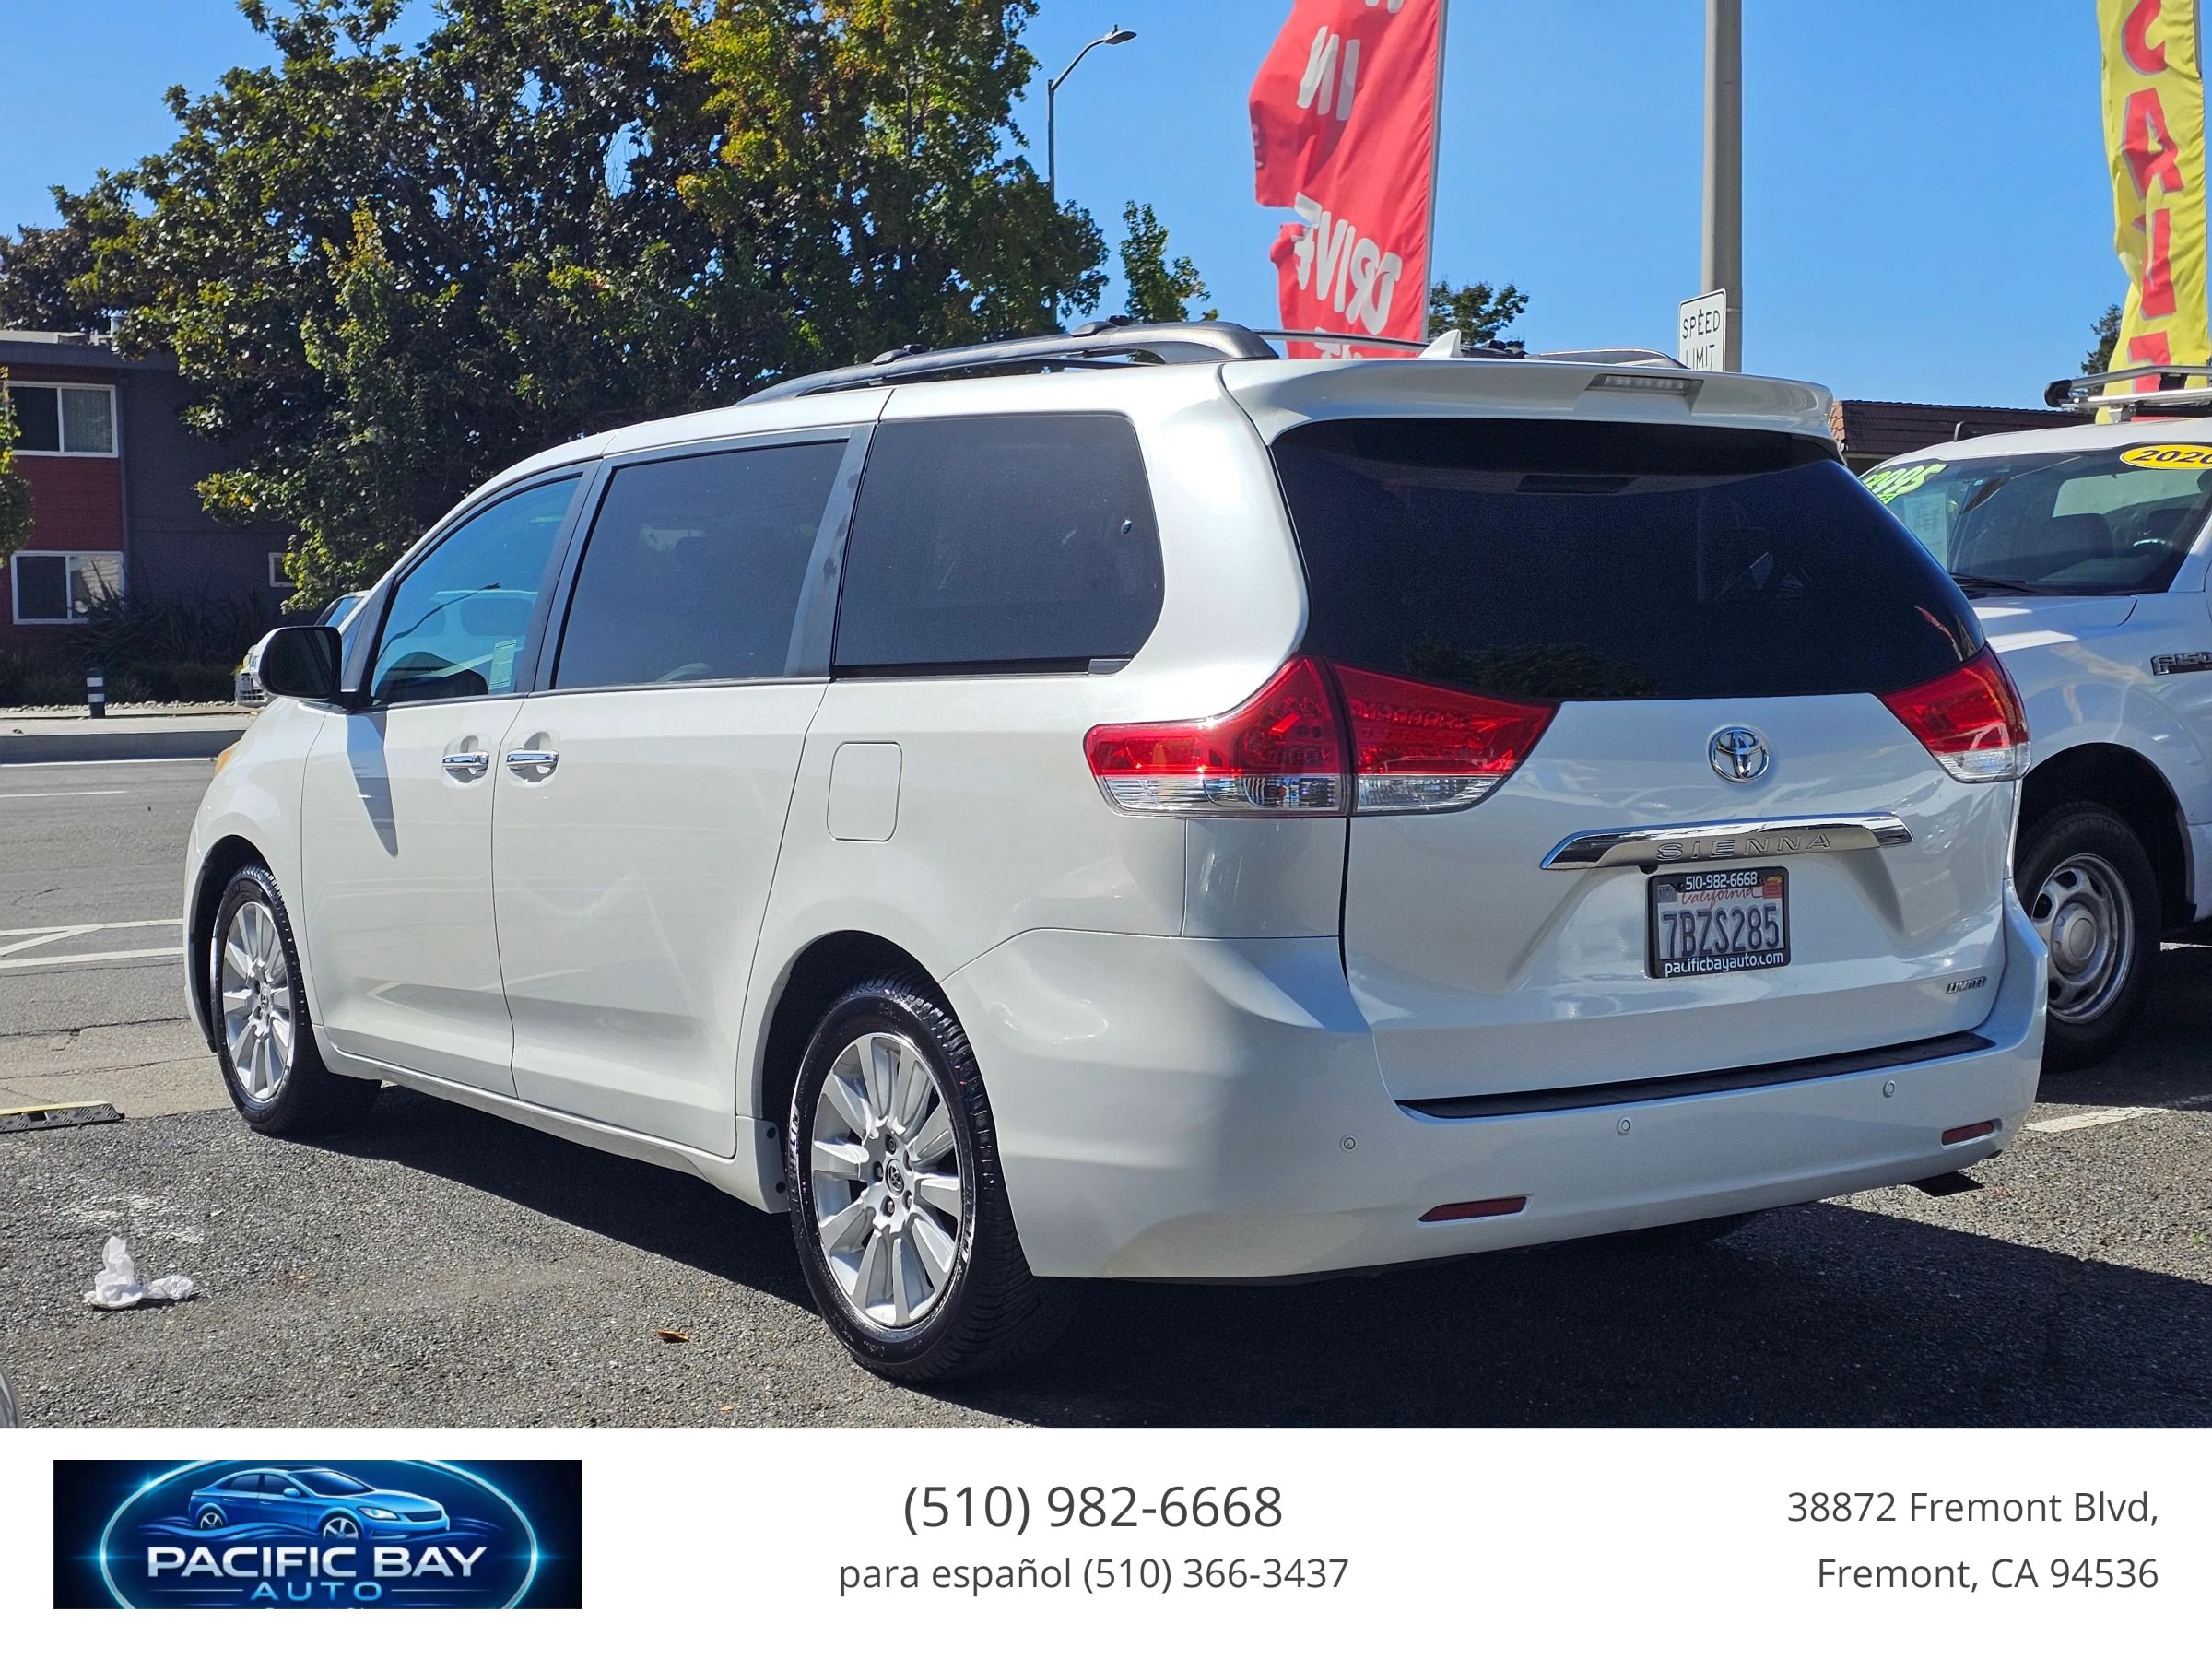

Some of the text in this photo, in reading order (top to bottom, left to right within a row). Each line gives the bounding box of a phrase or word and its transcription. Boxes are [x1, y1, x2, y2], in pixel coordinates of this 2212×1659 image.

[1682, 309, 1721, 339] SPEED
[1656, 832, 1831, 862] SIENNA
[1685, 871, 1758, 891] 510-982-6668
[1681, 885, 1764, 910] California
[1662, 904, 1780, 959] 7BZS285
[1665, 951, 1783, 978] pacificbayauto.com
